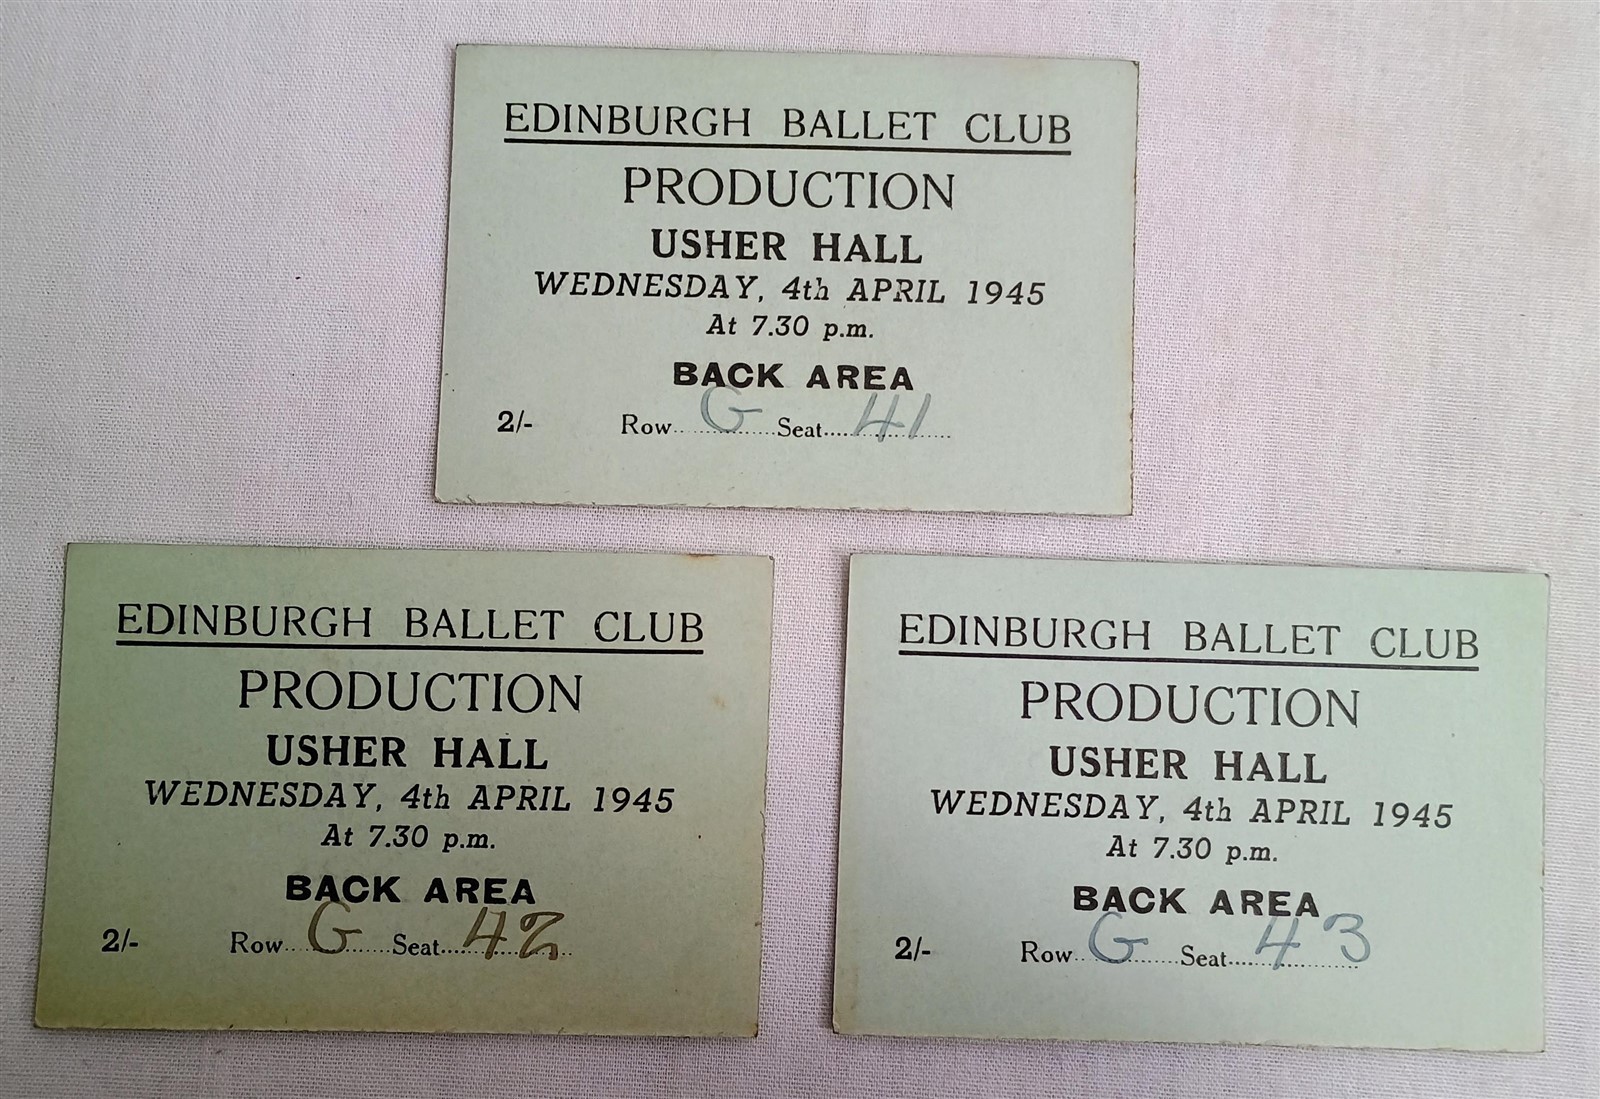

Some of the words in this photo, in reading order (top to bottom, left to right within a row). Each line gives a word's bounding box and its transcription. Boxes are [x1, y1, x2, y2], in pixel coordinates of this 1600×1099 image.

[506, 103, 750, 137] EDINBURGH
[783, 108, 937, 140] BALLET
[965, 113, 1070, 144] CLUB
[624, 167, 955, 211] PRODUCTION
[651, 228, 787, 261] USHER
[813, 232, 922, 264] HALL
[534, 271, 763, 303] WEDNESDAY,
[782, 276, 829, 301] 4th
[846, 278, 945, 303] APRIL
[968, 281, 1045, 305] 1945
[706, 314, 737, 335] At
[753, 315, 809, 336] 7.30
[823, 323, 873, 341] p.m.
[673, 362, 784, 388] BACK
[806, 365, 914, 391] AREA
[497, 410, 532, 433] 2/-
[701, 386, 762, 433] G
[852, 393, 933, 441] 41
[118, 603, 371, 637] EDINBURGH
[406, 608, 564, 640] BALLET
[594, 611, 703, 643] CLUB
[900, 614, 1150, 650] EDINBURGH
[1184, 621, 1341, 655] BALLET
[1370, 627, 1478, 659] CLUB
[239, 670, 583, 713] PRODUCTION
[1021, 681, 1360, 728] PRODUCTION
[267, 734, 407, 767] USHER
[434, 737, 548, 769] HALL
[1049, 746, 1188, 780] USHER
[1214, 750, 1327, 784] HALL
[145, 780, 381, 812] WEDNESDAY,
[400, 784, 450, 809] 4th
[467, 785, 570, 811] APRIL
[594, 787, 675, 813] 1945
[931, 789, 1164, 824] WEDNESDAY,
[1183, 796, 1231, 822] 4th
[1249, 798, 1350, 825] APRIL
[1373, 802, 1453, 828] 1945
[321, 824, 353, 846] At
[370, 825, 428, 848] 7.30
[442, 833, 495, 853] p.m.
[1106, 835, 1137, 857] At
[1154, 837, 1211, 859] 7.30
[1225, 846, 1277, 865] p.m.
[286, 875, 401, 903] BACK
[424, 877, 535, 904] AREA
[1074, 886, 1187, 914] BACK
[1209, 889, 1319, 917] AREA
[102, 928, 138, 952] 2/-
[309, 901, 362, 955] G
[463, 909, 564, 959] 42
[1088, 913, 1148, 963] G
[895, 936, 931, 961] 2/-
